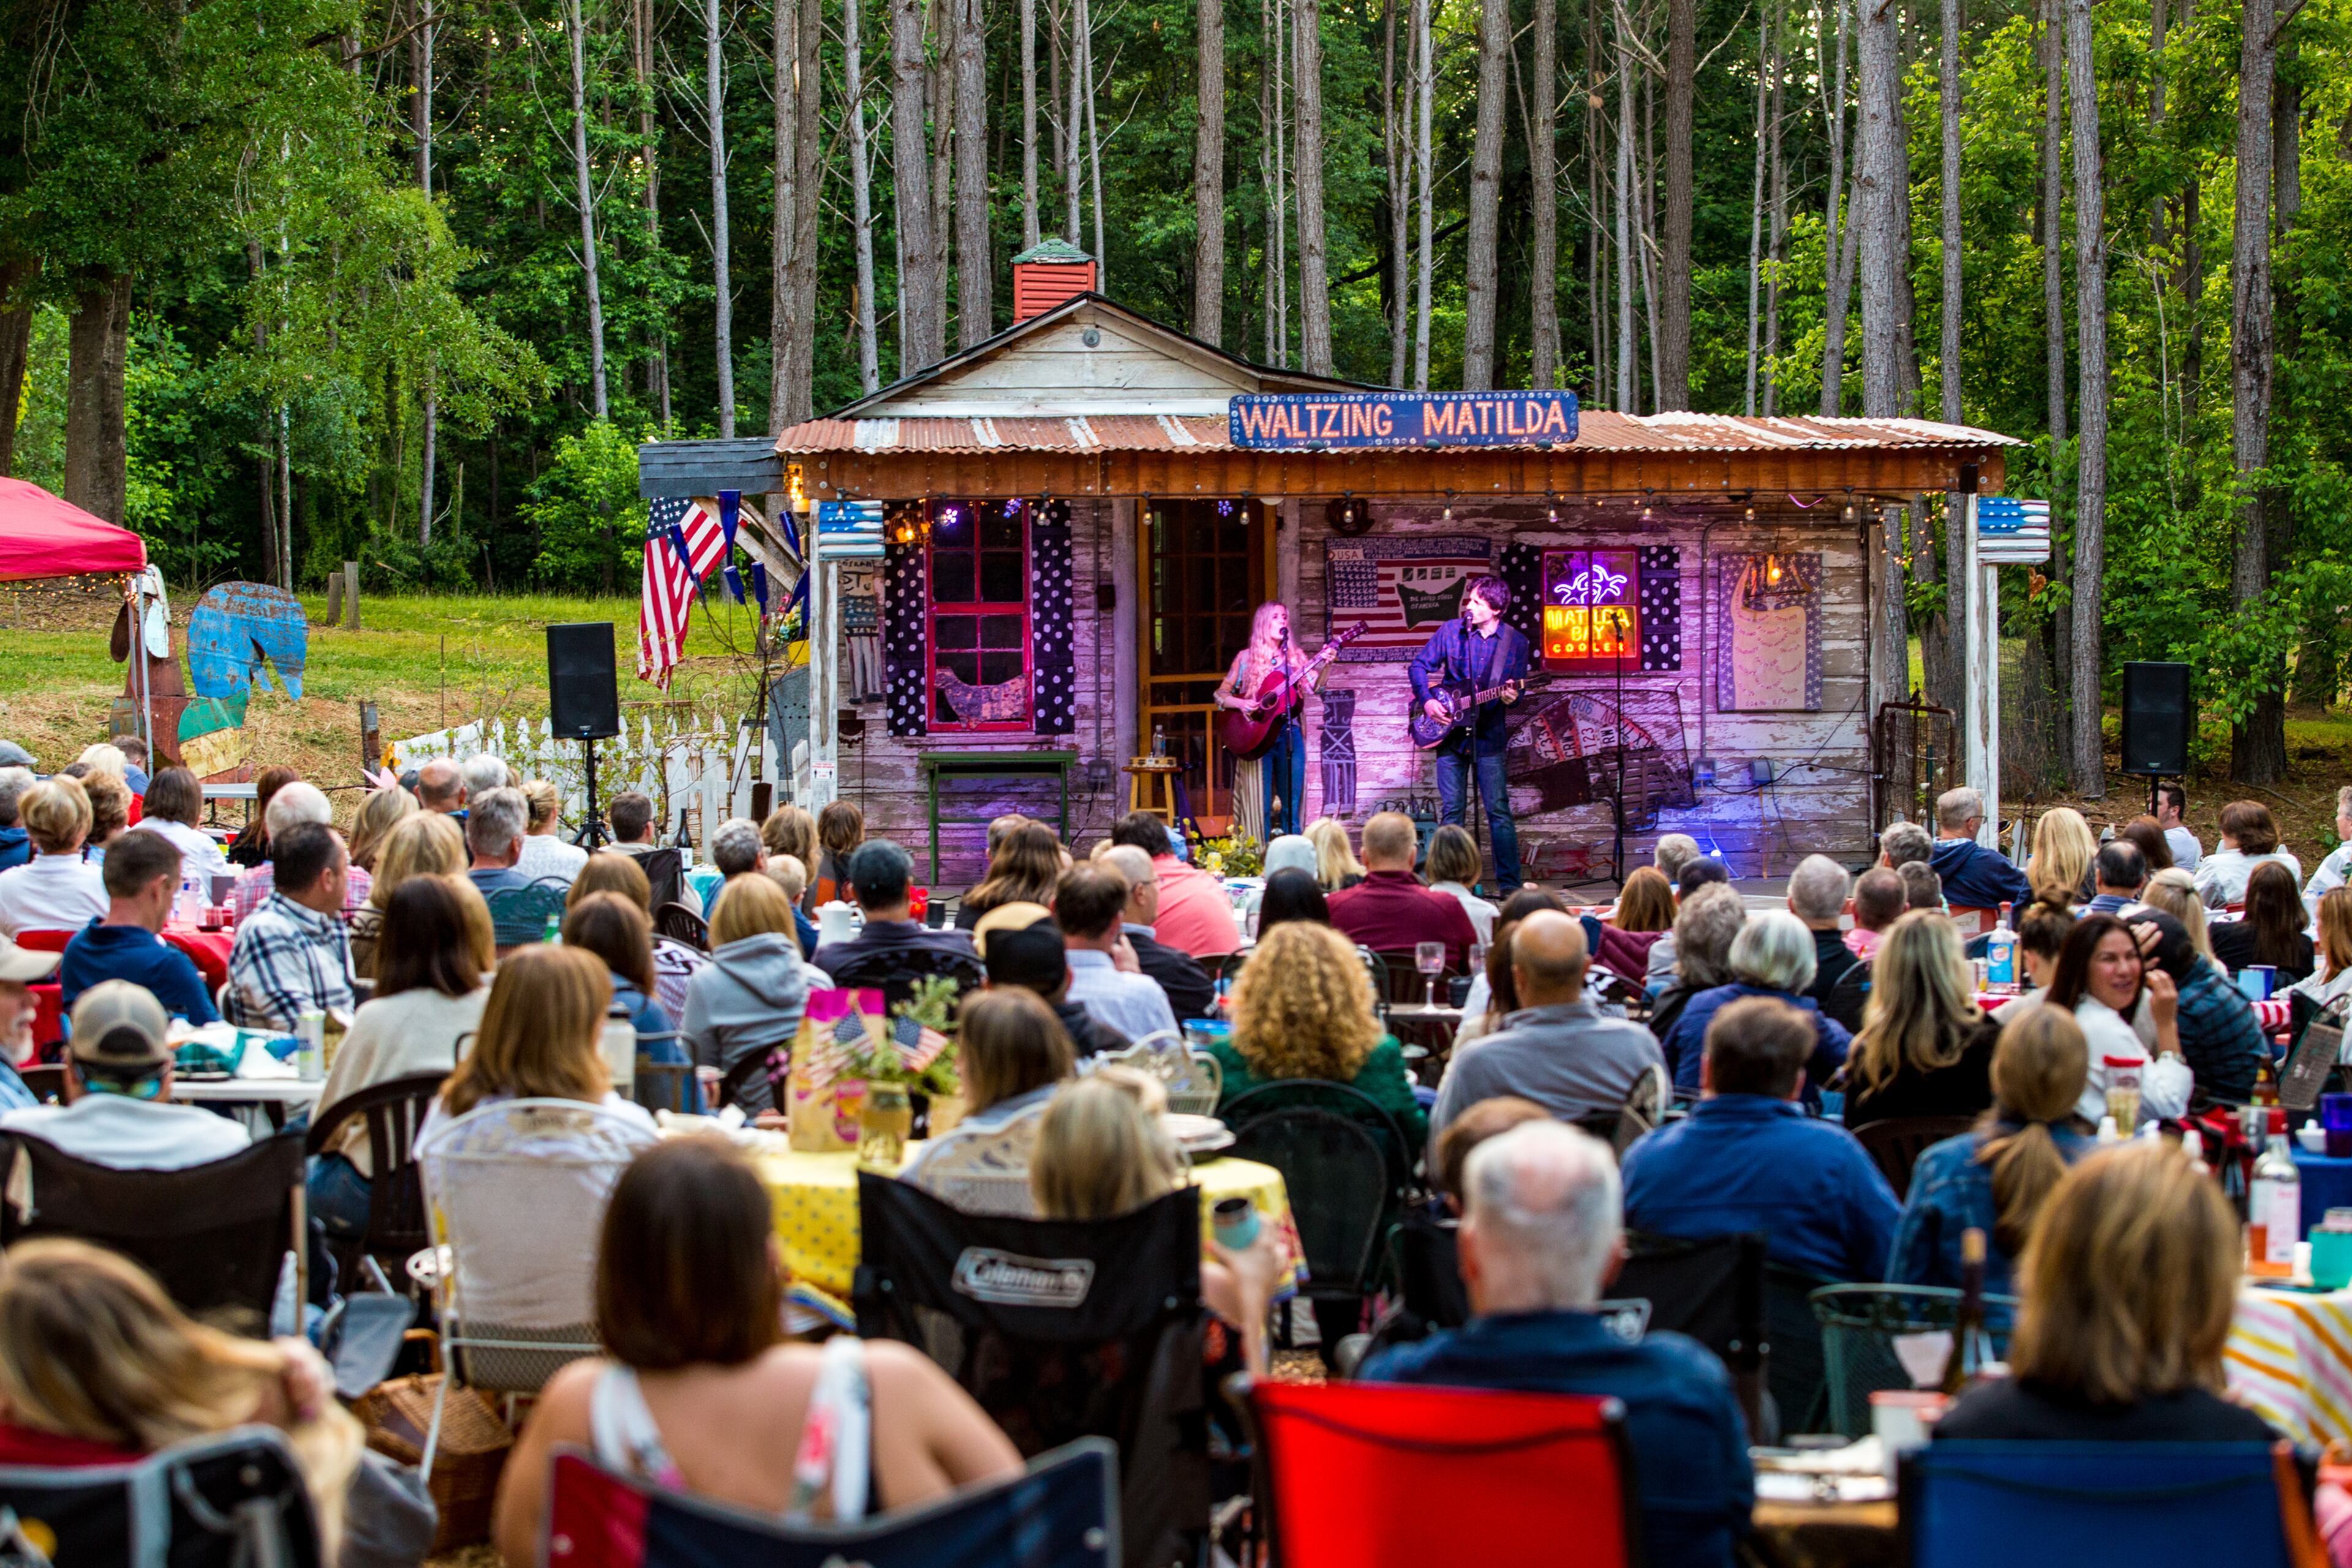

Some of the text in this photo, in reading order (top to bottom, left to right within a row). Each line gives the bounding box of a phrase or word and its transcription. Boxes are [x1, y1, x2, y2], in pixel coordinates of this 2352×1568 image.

[1238, 399, 1568, 439] WALTZING MATILDA
[1337, 551, 1359, 559] USA
[1547, 608, 1630, 630] MATLDA
[1562, 736, 1577, 758] CRW
[1581, 727, 1596, 748] 123
[1600, 729, 1615, 744] RW
[965, 1255, 1058, 1289] Coleman
